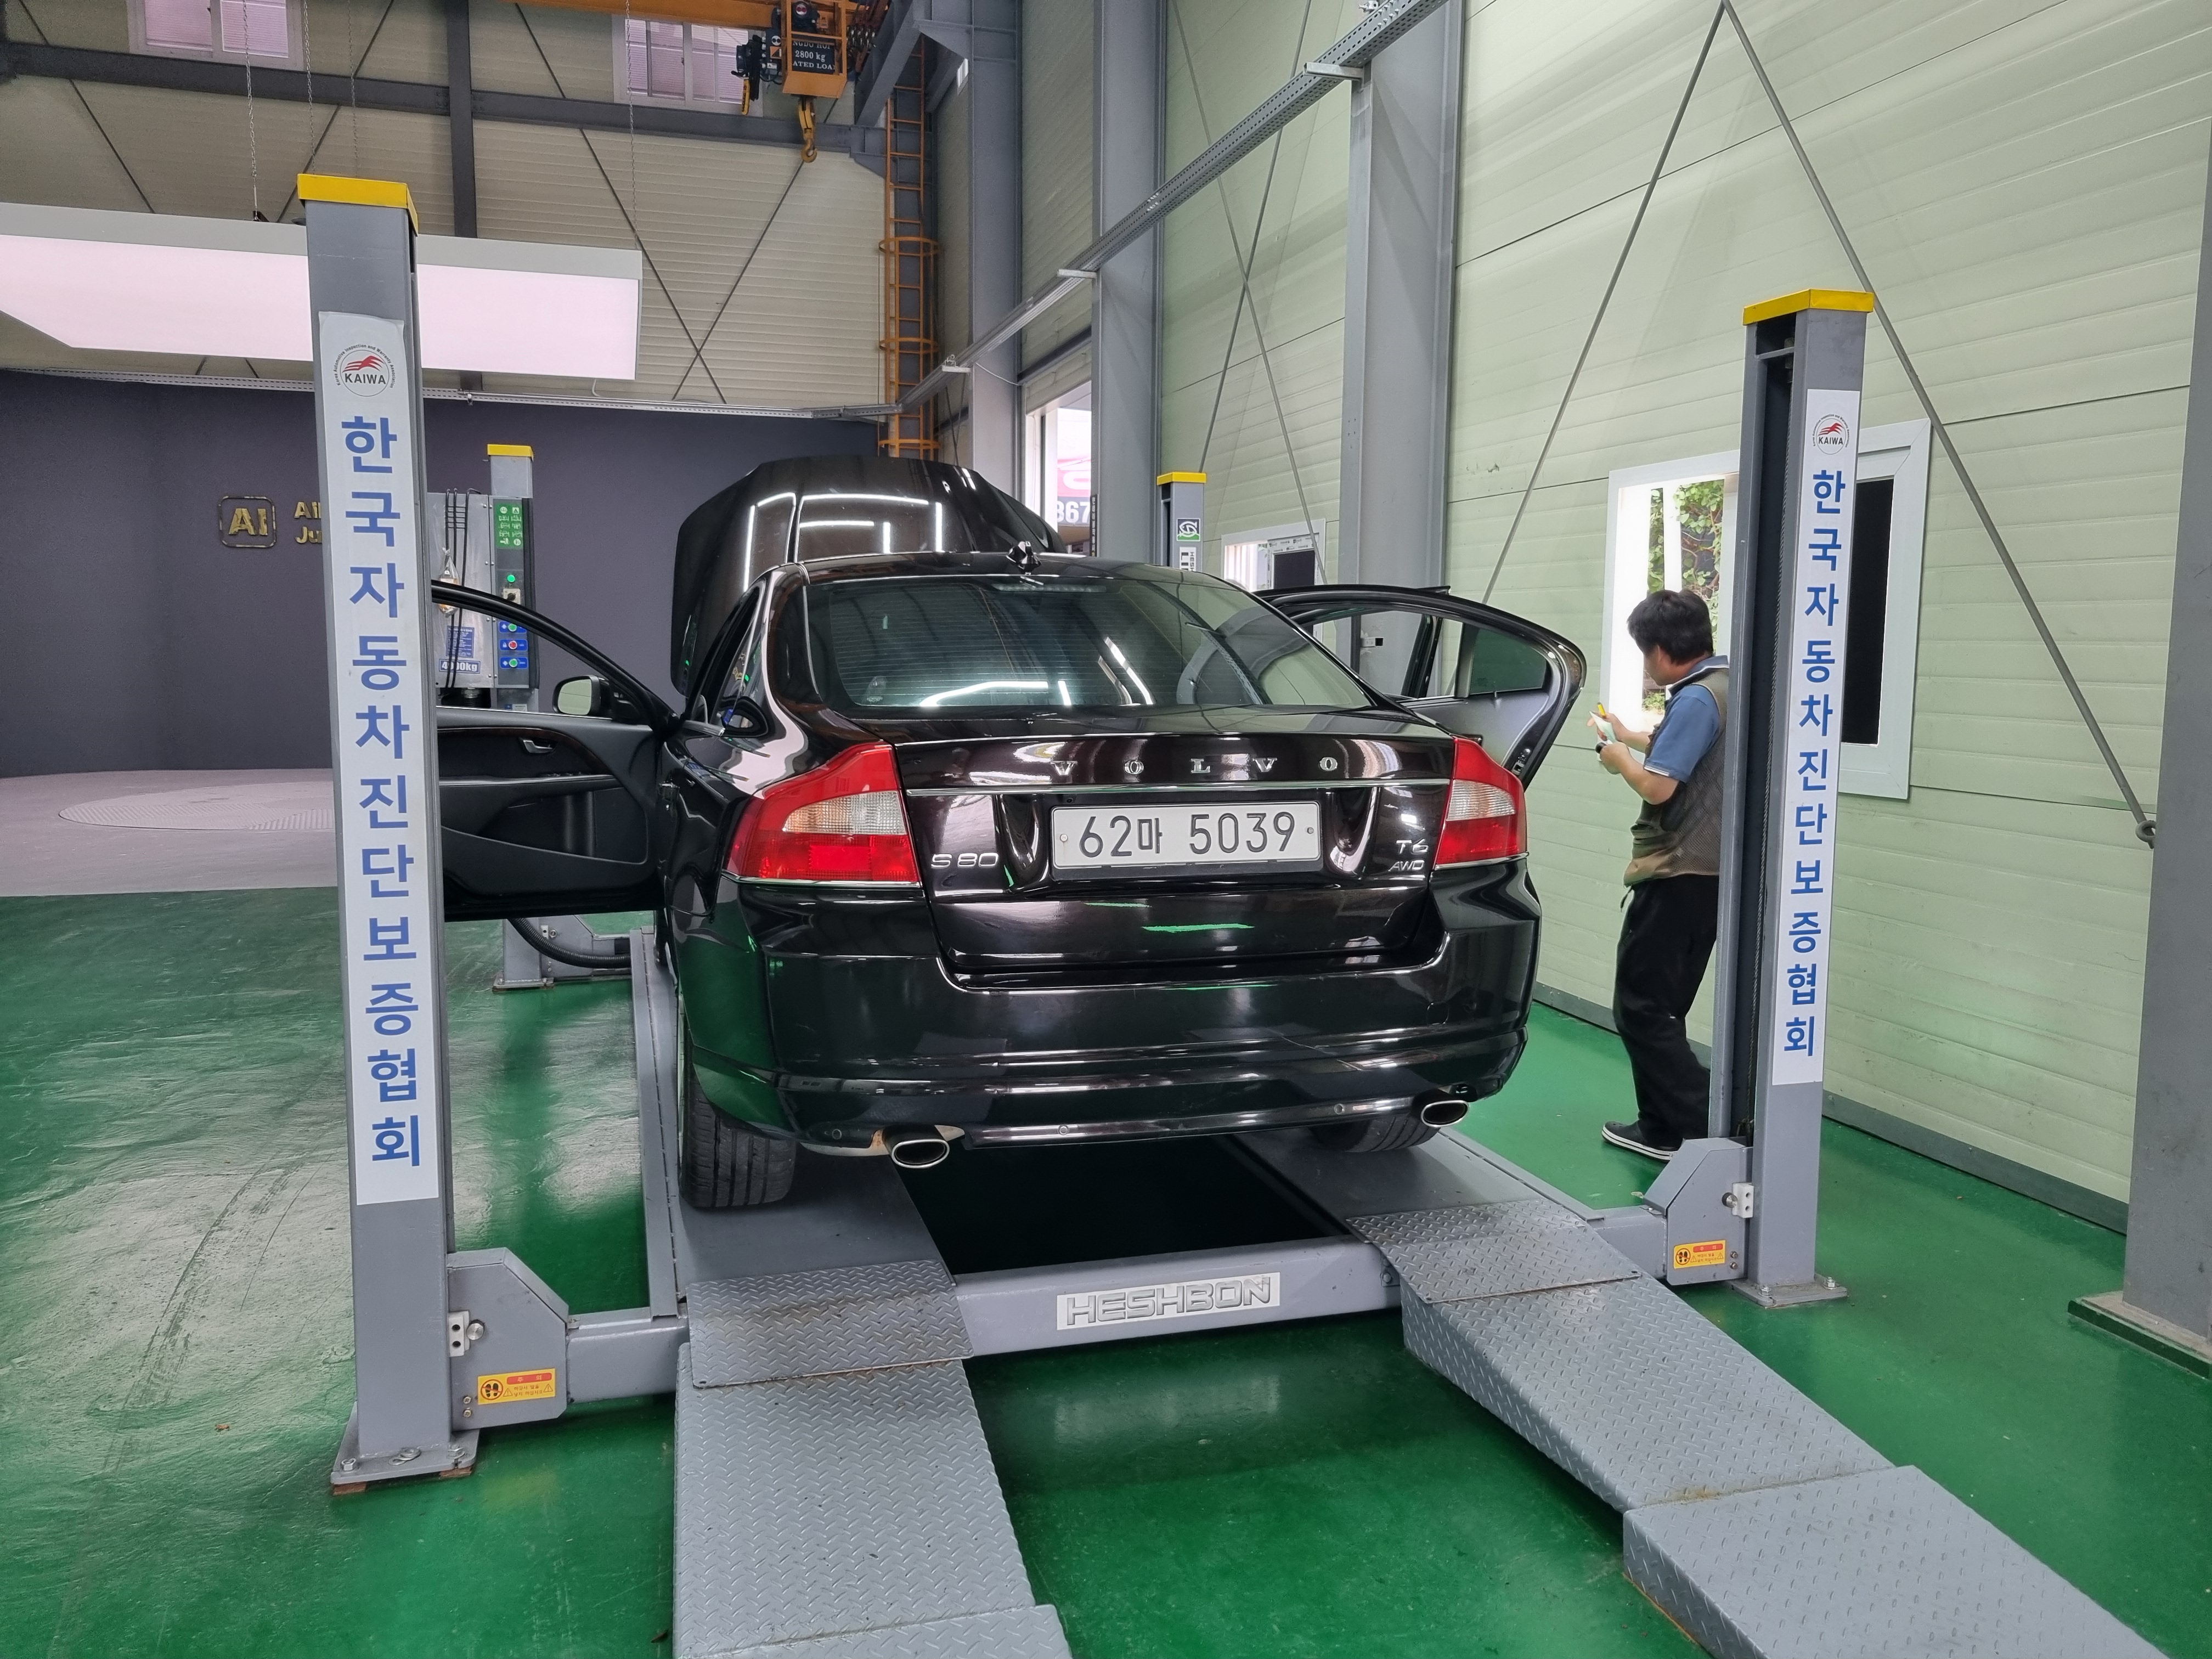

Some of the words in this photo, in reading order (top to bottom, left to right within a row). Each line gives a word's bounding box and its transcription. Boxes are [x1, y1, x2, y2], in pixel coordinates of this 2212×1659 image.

[795, 50, 814, 59] 2800
[816, 52, 826, 63] kg
[335, 351, 346, 373] Automotive
[344, 344, 367, 353] Inspection
[376, 348, 392, 364] Warranty
[345, 373, 386, 385] KAIWA
[1818, 436, 1844, 445] KAIWA
[1050, 757, 1339, 776] VOLVO
[1784, 469, 1846, 1057] 한국자동차진단보증협회
[341, 415, 421, 1167] 한국자동차진단보증협회
[1079, 816, 1163, 857] 62마
[1189, 811, 1295, 855] 5039
[1396, 838, 1429, 854] T6
[1388, 860, 1425, 871] AWD
[1066, 1277, 1271, 1325] HESHBON
